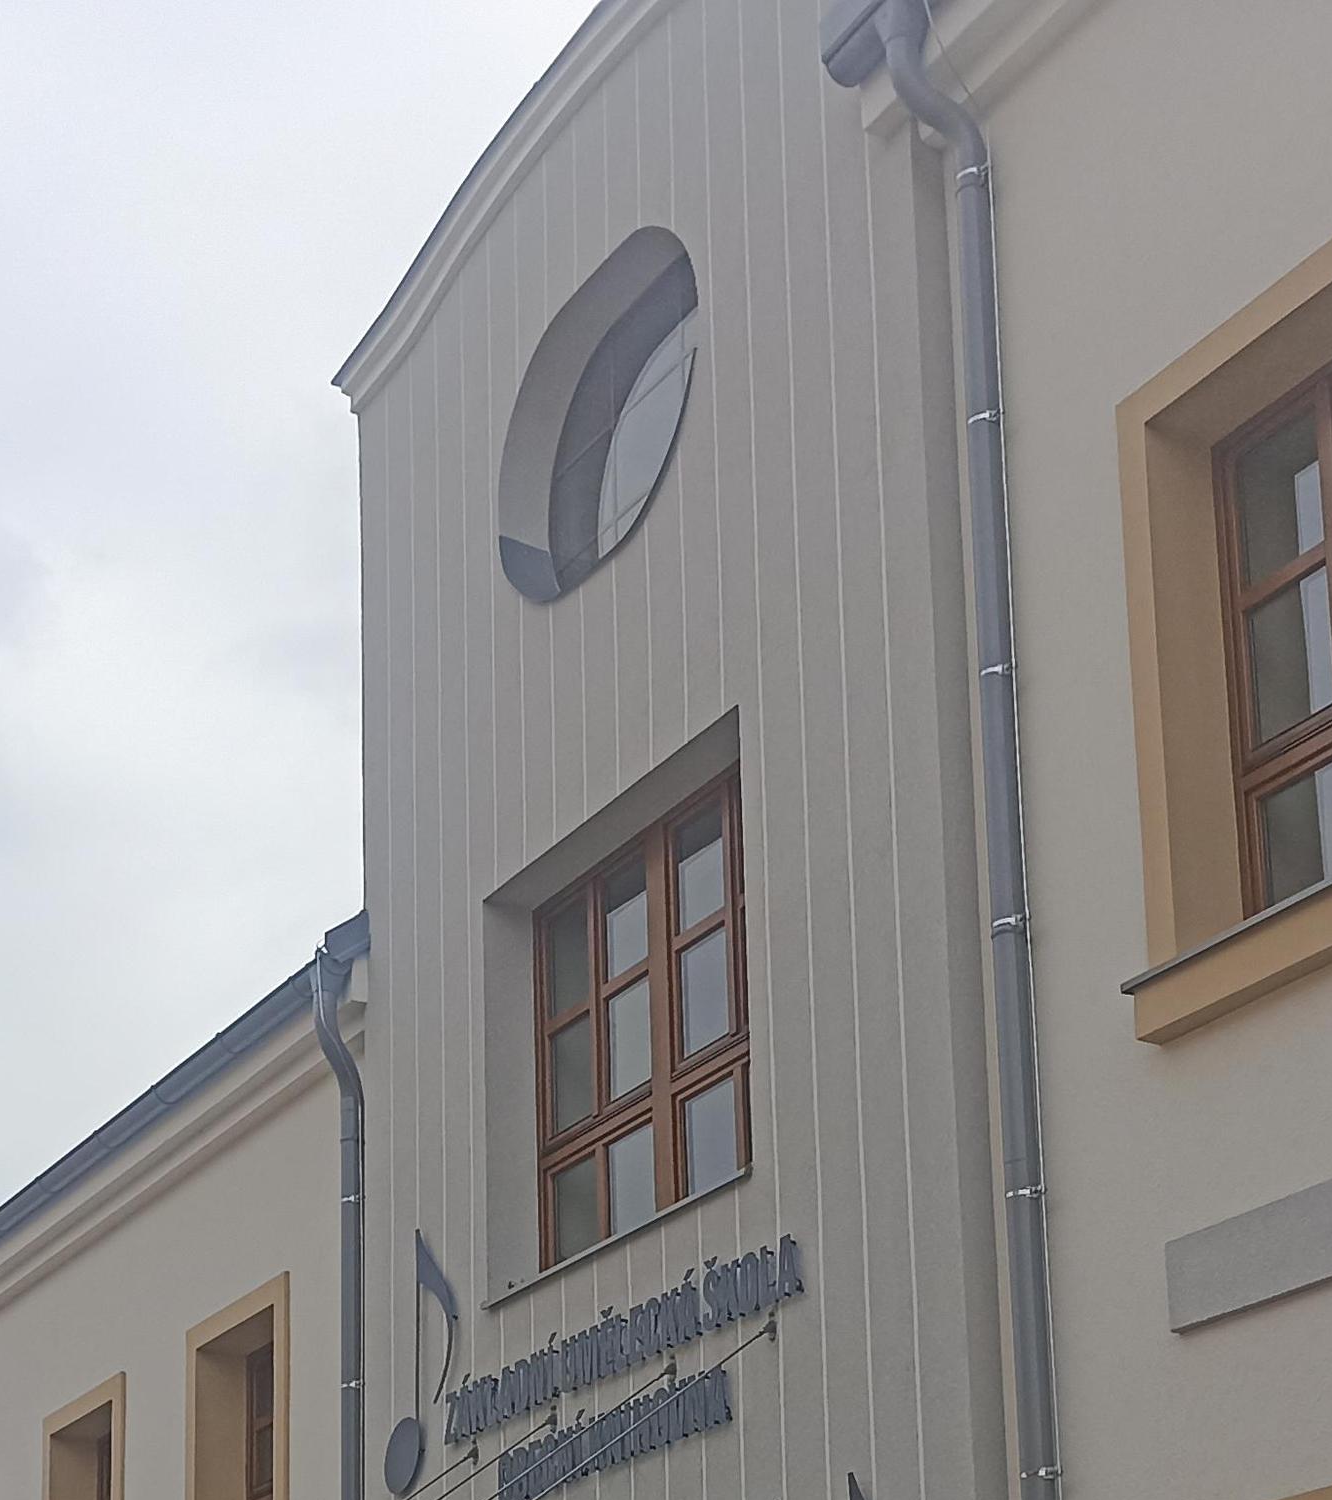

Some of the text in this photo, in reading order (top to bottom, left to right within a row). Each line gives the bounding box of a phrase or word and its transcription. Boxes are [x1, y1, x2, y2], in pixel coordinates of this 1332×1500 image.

[445, 1233, 804, 1445] ZÁKLADNÍ UMĚLECKÁ ŠKOLA
[588, 1368, 733, 1475] KNIHOVNA
